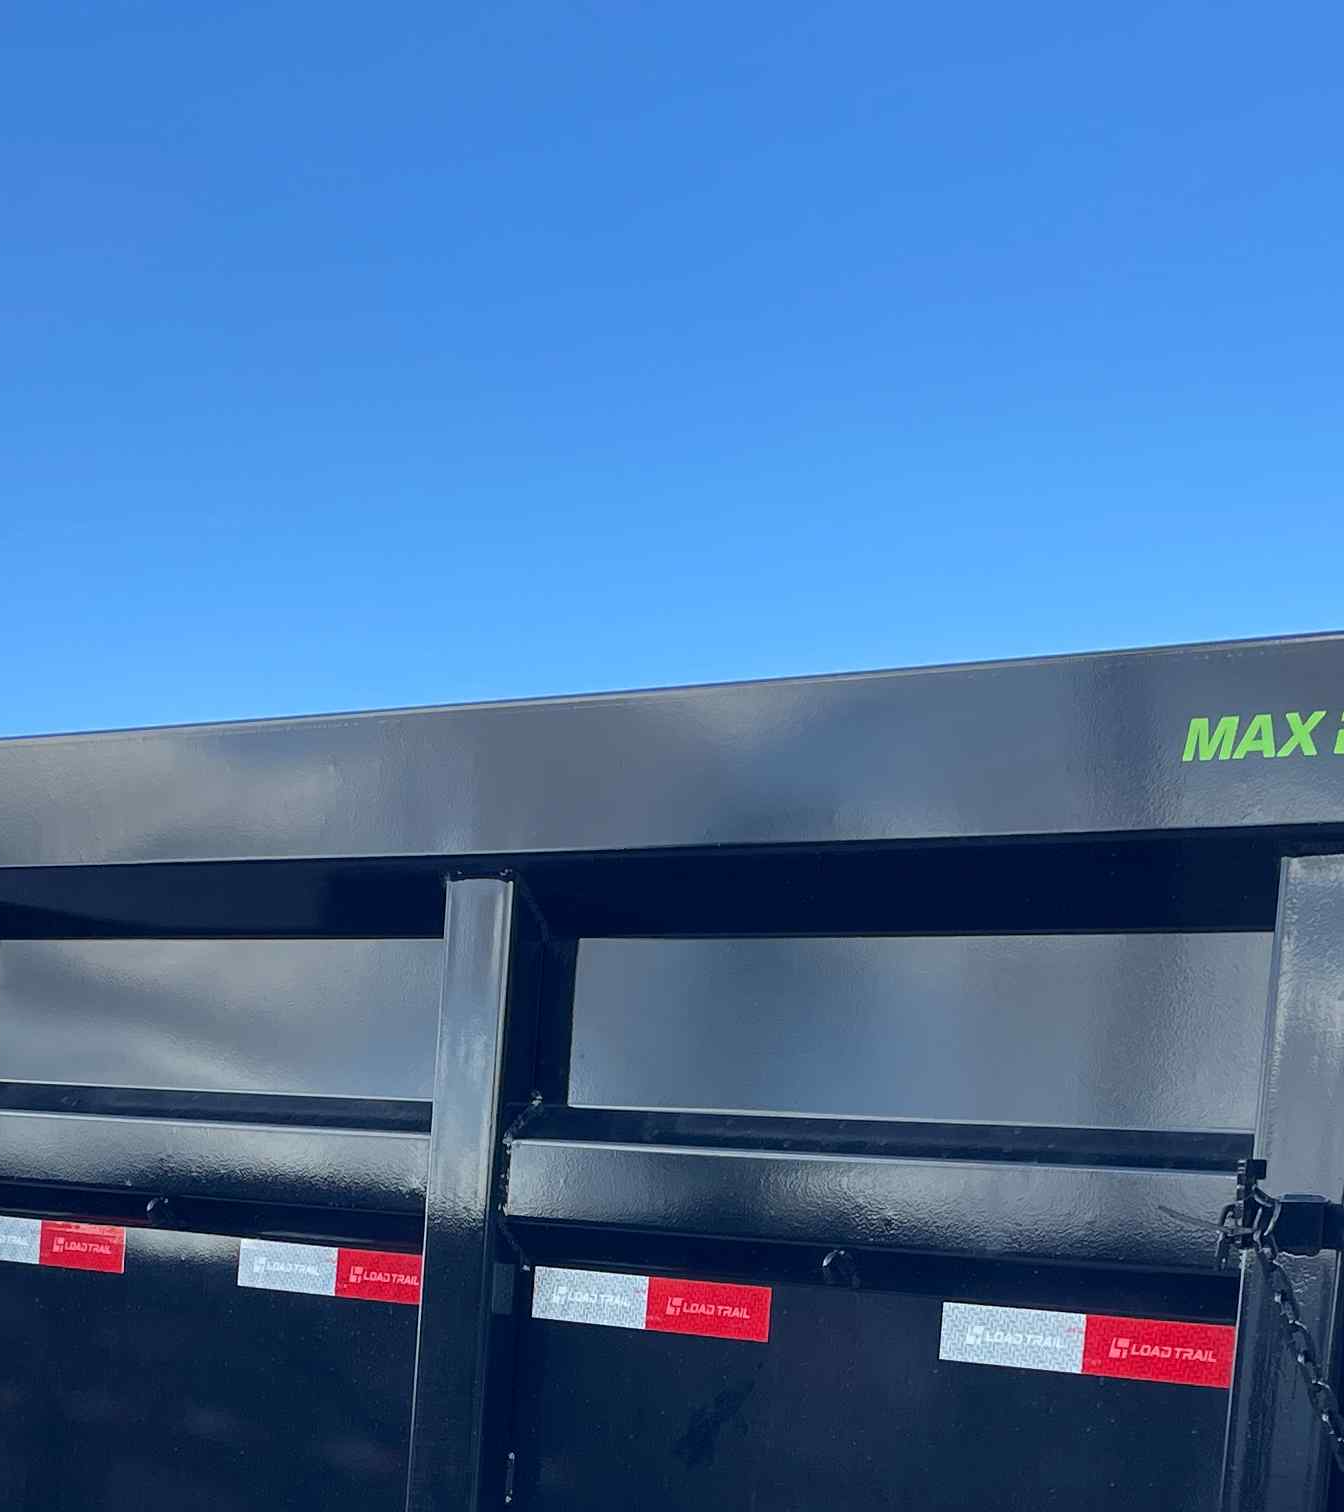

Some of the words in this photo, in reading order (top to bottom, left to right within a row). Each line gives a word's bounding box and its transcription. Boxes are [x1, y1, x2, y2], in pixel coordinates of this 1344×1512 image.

[1182, 711, 1327, 762] MAX
[64, 1242, 88, 1254] LOAD
[87, 1244, 112, 1255] TRAIL
[363, 1271, 391, 1283] LOAD
[391, 1274, 419, 1286] TRAIL
[683, 1302, 716, 1316] LOAD
[717, 1305, 751, 1320] TRAIL
[985, 1330, 1024, 1344] LOAD
[1024, 1334, 1064, 1349] TRAIL
[1131, 1344, 1172, 1359] LOAD
[1173, 1347, 1217, 1363] TRAIL
